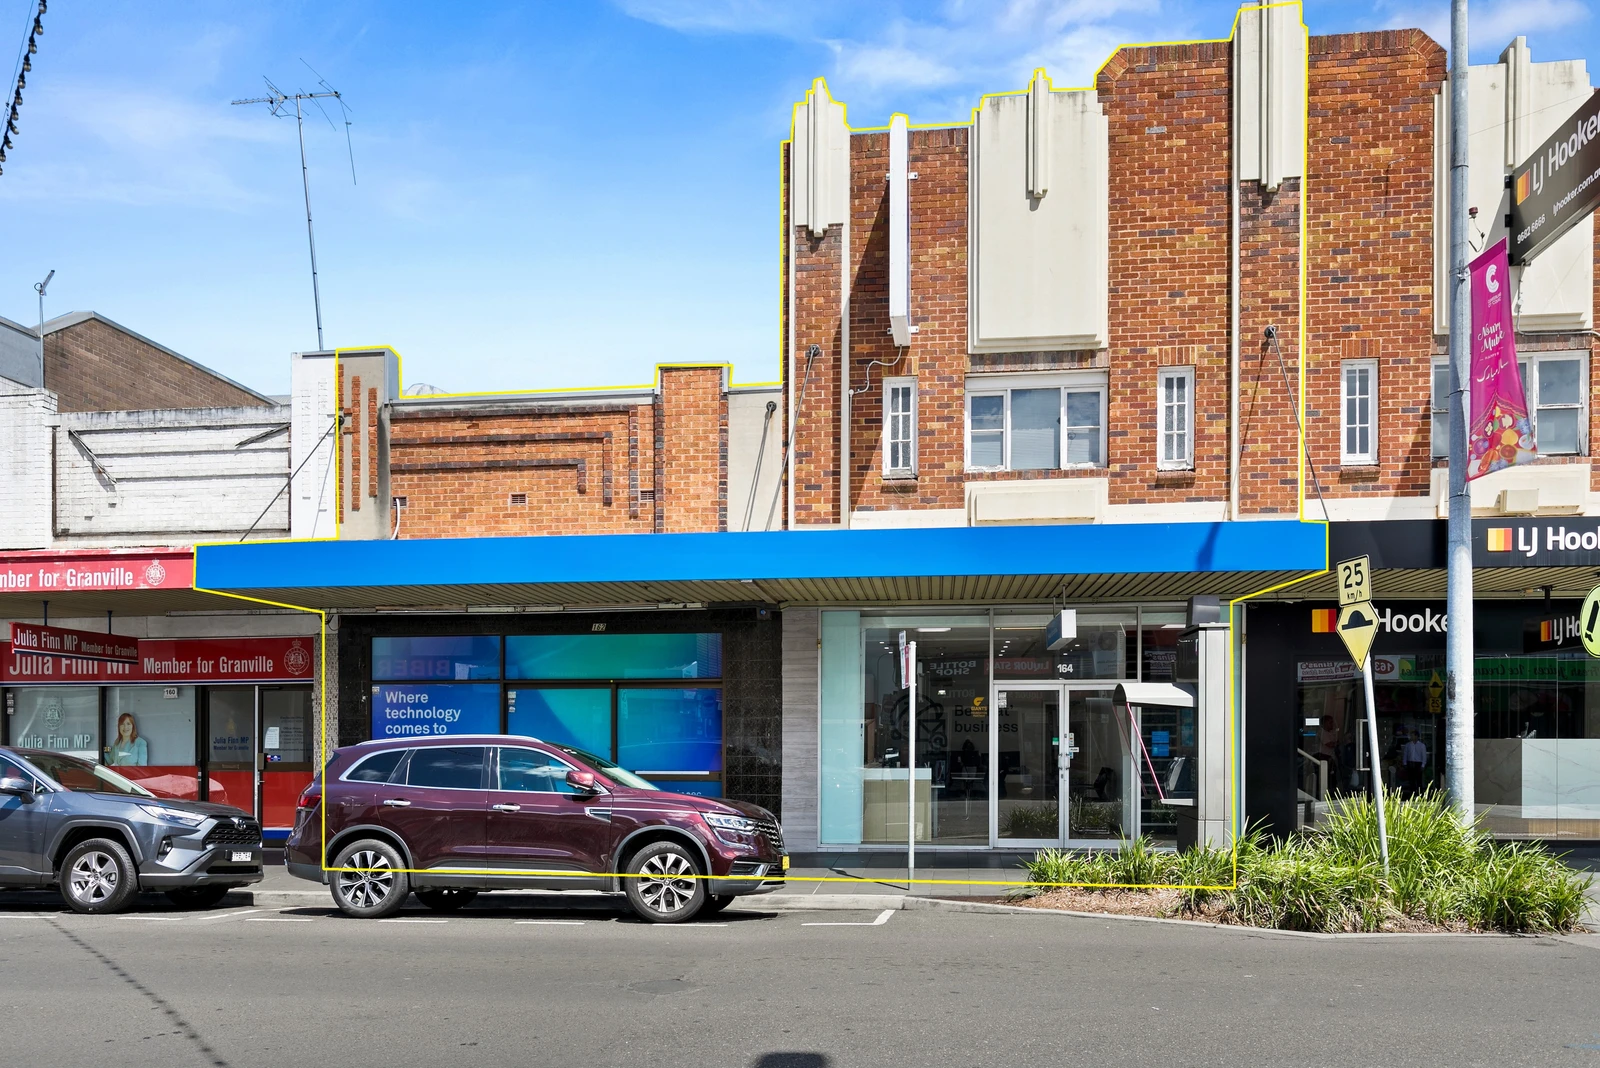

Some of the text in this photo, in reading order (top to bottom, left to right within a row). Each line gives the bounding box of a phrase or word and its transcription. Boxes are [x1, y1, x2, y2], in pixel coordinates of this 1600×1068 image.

[1532, 156, 1544, 196] LJ
[1531, 213, 1546, 234] 6666
[1552, 168, 1600, 217] ljhooker.com.a
[1518, 526, 1600, 557] LJ Hoo
[0, 568, 134, 588] mber for Granville
[1343, 562, 1364, 589] 25
[1347, 589, 1363, 602] km/h
[592, 623, 607, 631] 162
[1553, 617, 1563, 645] LJ
[14, 628, 138, 657] Julia Finn MP Member for Granville
[143, 657, 192, 674] Member
[197, 656, 215, 673] for
[219, 656, 274, 673] Granville
[1057, 664, 1074, 673] 164
[385, 691, 429, 704] Where
[384, 706, 461, 722] technology
[385, 722, 447, 734] comes to
[47, 734, 69, 748] Finn
[73, 734, 91, 748] MP
[213, 736, 249, 744] Julia Finn MP
